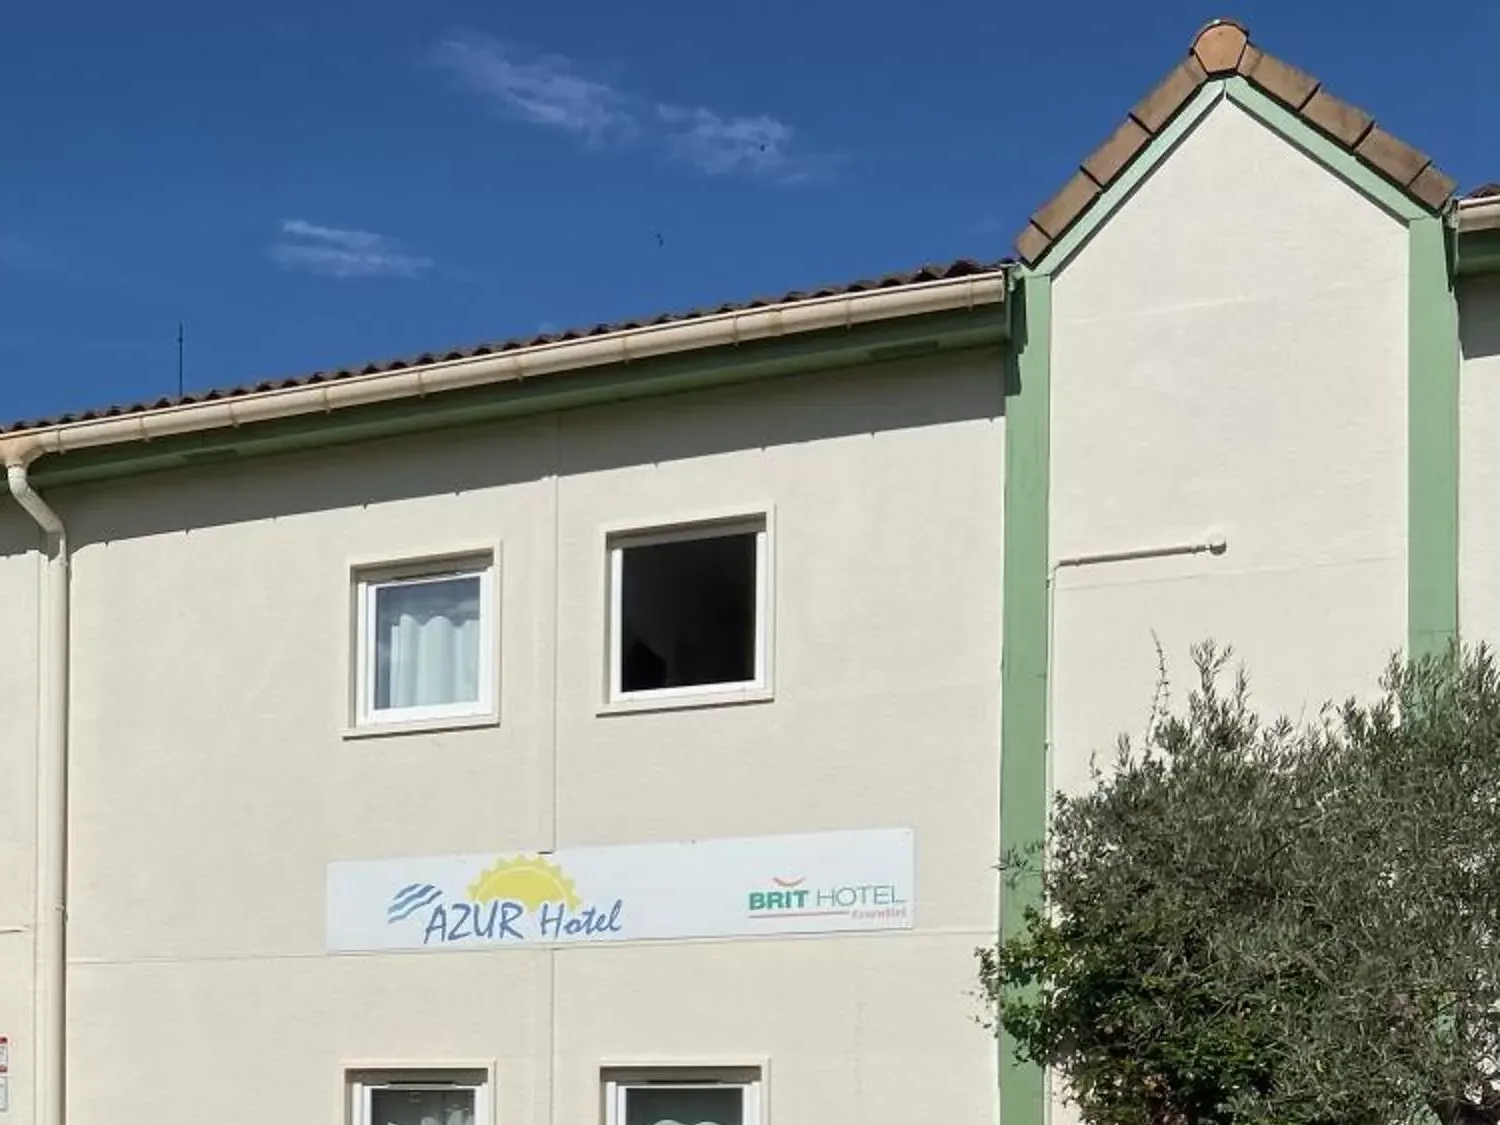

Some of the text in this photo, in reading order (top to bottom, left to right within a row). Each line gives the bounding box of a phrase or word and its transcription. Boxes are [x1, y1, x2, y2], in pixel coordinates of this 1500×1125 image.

[748, 885, 907, 910] BRIT HOTEL
[423, 900, 623, 945] AZUR Hotel
